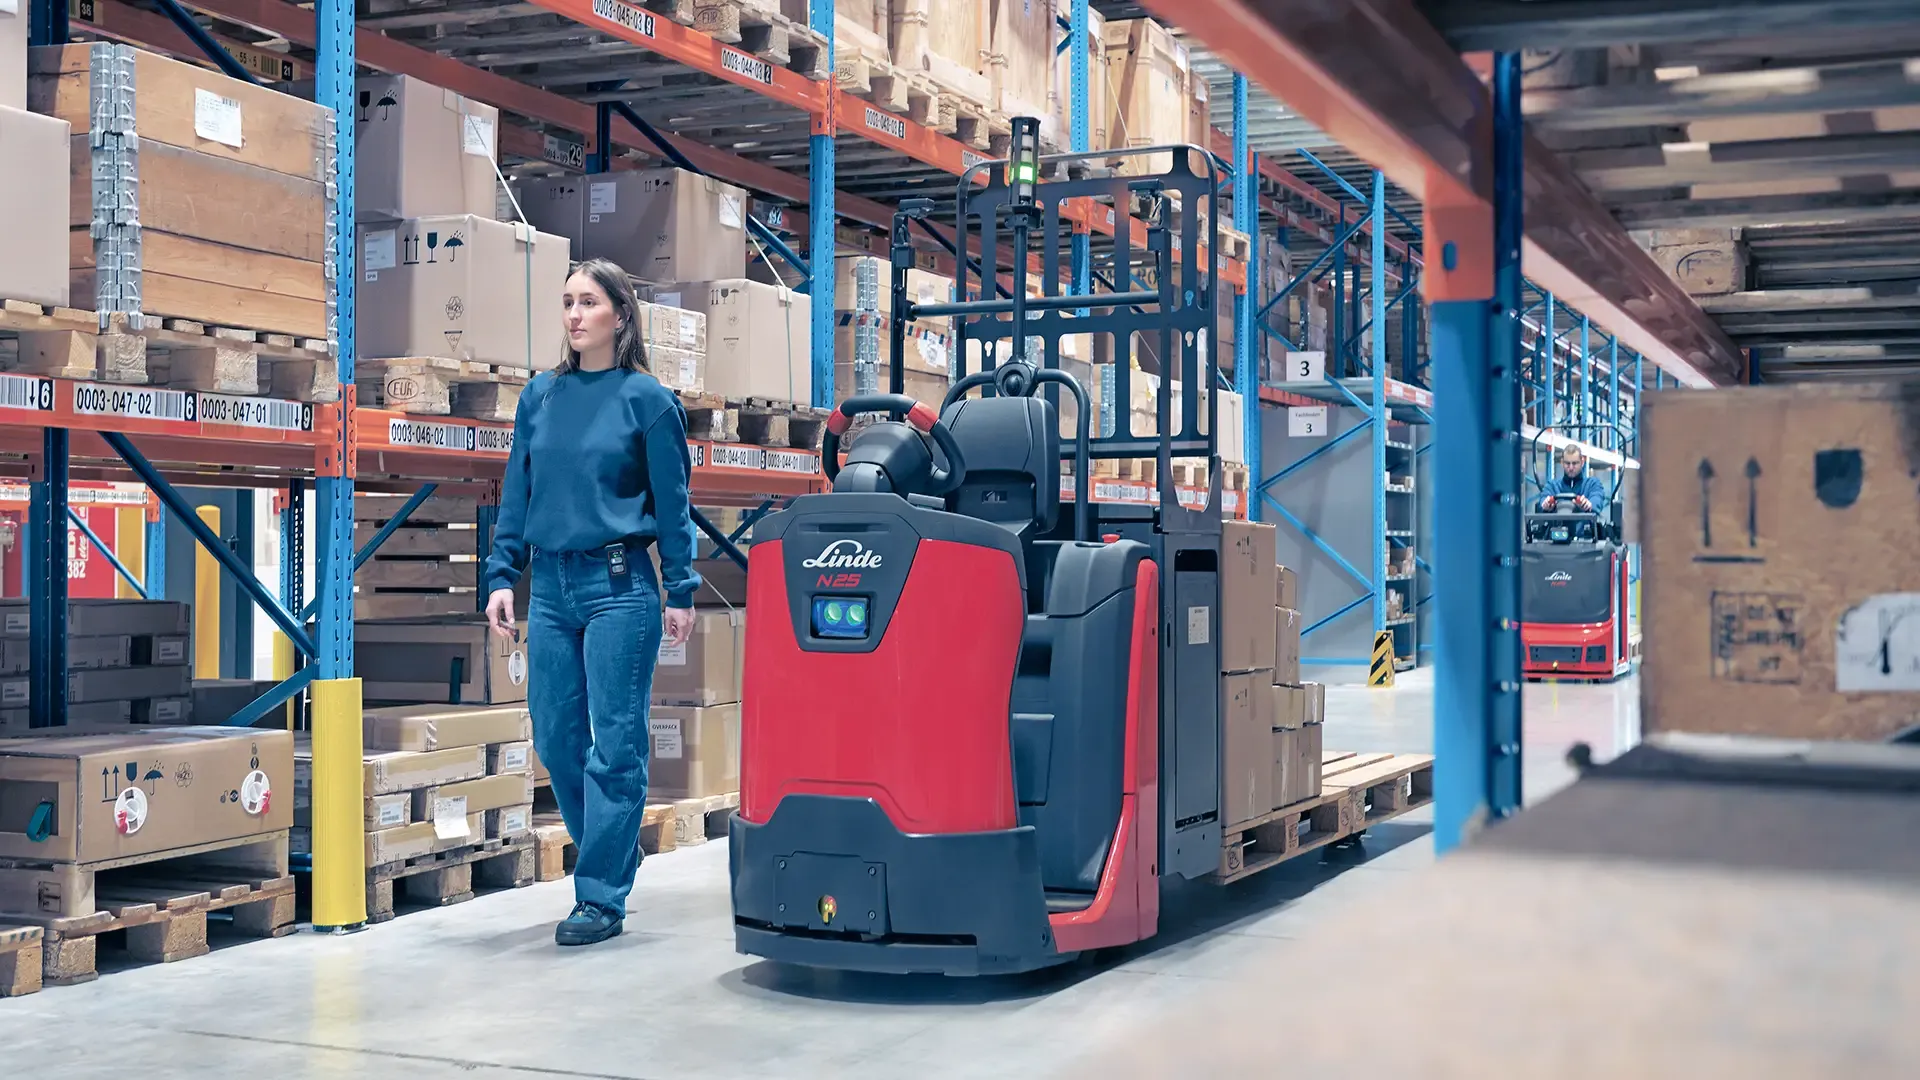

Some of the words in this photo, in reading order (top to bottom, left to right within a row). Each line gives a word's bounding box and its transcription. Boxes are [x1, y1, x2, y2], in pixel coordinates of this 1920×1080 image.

[80, 2, 92, 17] 38
[593, 0, 643, 32] 0003-045-03
[283, 65, 291, 77] 21
[722, 50, 763, 79] 0003-044-03
[570, 144, 582, 167] 29
[1300, 360, 1310, 377] 3
[41, 381, 50, 408] 6
[393, 383, 413, 397] EUR
[76, 387, 152, 415] 0003-047-02
[186, 395, 194, 420] 6
[201, 398, 267, 423] 0003-047-01
[303, 406, 311, 429] 9
[391, 423, 444, 445] 0003-046-02
[467, 430, 473, 446] 9
[1306, 423, 1313, 434] 3
[697, 446, 704, 466] 5
[712, 448, 747, 465] 0003-044-02
[760, 451, 766, 468] 5
[802, 539, 883, 569] Linde
